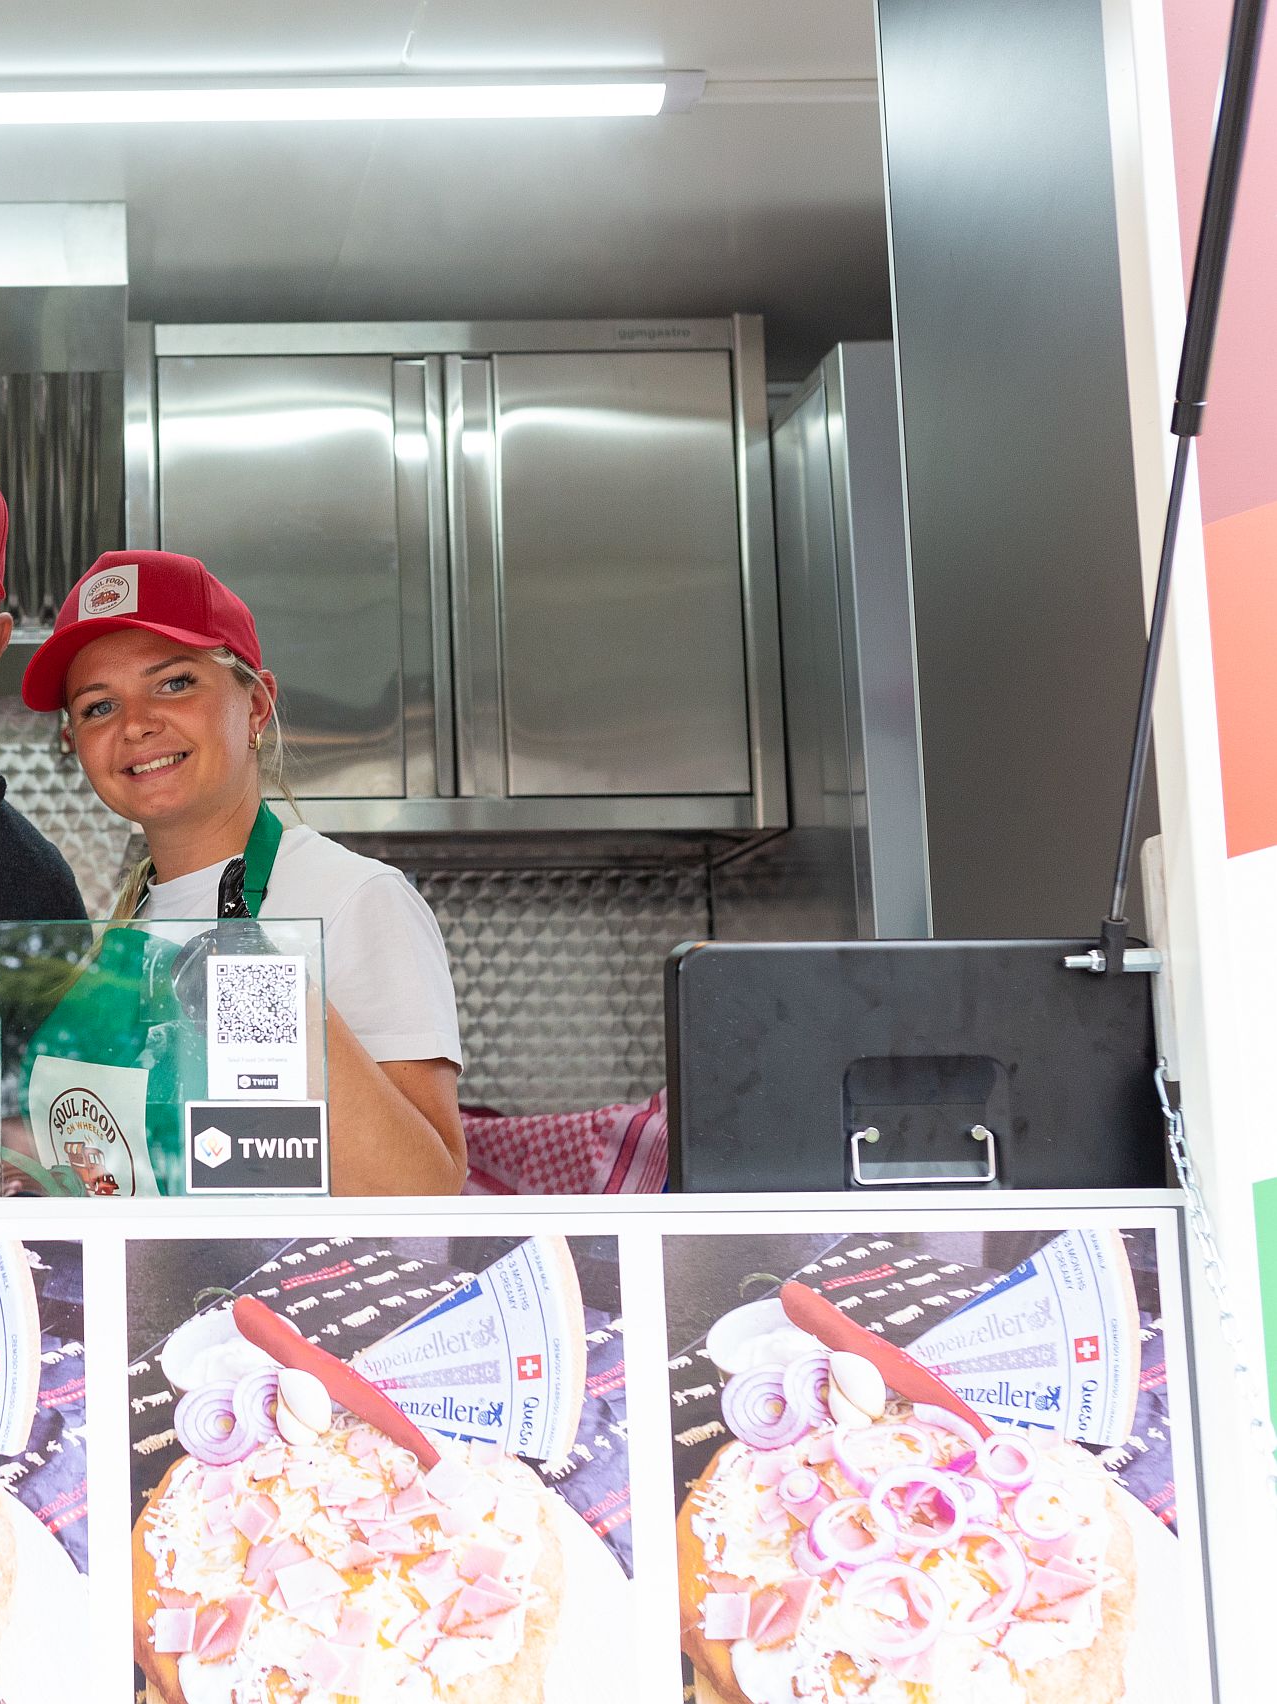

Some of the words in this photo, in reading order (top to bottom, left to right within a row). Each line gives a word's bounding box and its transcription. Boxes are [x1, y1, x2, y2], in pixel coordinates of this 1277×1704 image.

[88, 581, 105, 597] SOUL
[105, 577, 124, 586] FOOD
[53, 1098, 79, 1135] SOUL
[82, 1098, 116, 1143] FOOD
[66, 1123, 75, 1135] ON
[76, 1121, 104, 1140] WHEELS
[238, 1137, 319, 1159] TWINT
[500, 1271, 517, 1311] CREAMY
[510, 1269, 530, 1311] MONTHS
[10, 1334, 18, 1370] CREMOSO
[363, 1330, 471, 1376] Appenzeller
[916, 1313, 1026, 1361] Appenzeller
[518, 1396, 540, 1446] Queso
[1078, 1379, 1099, 1431] Queso
